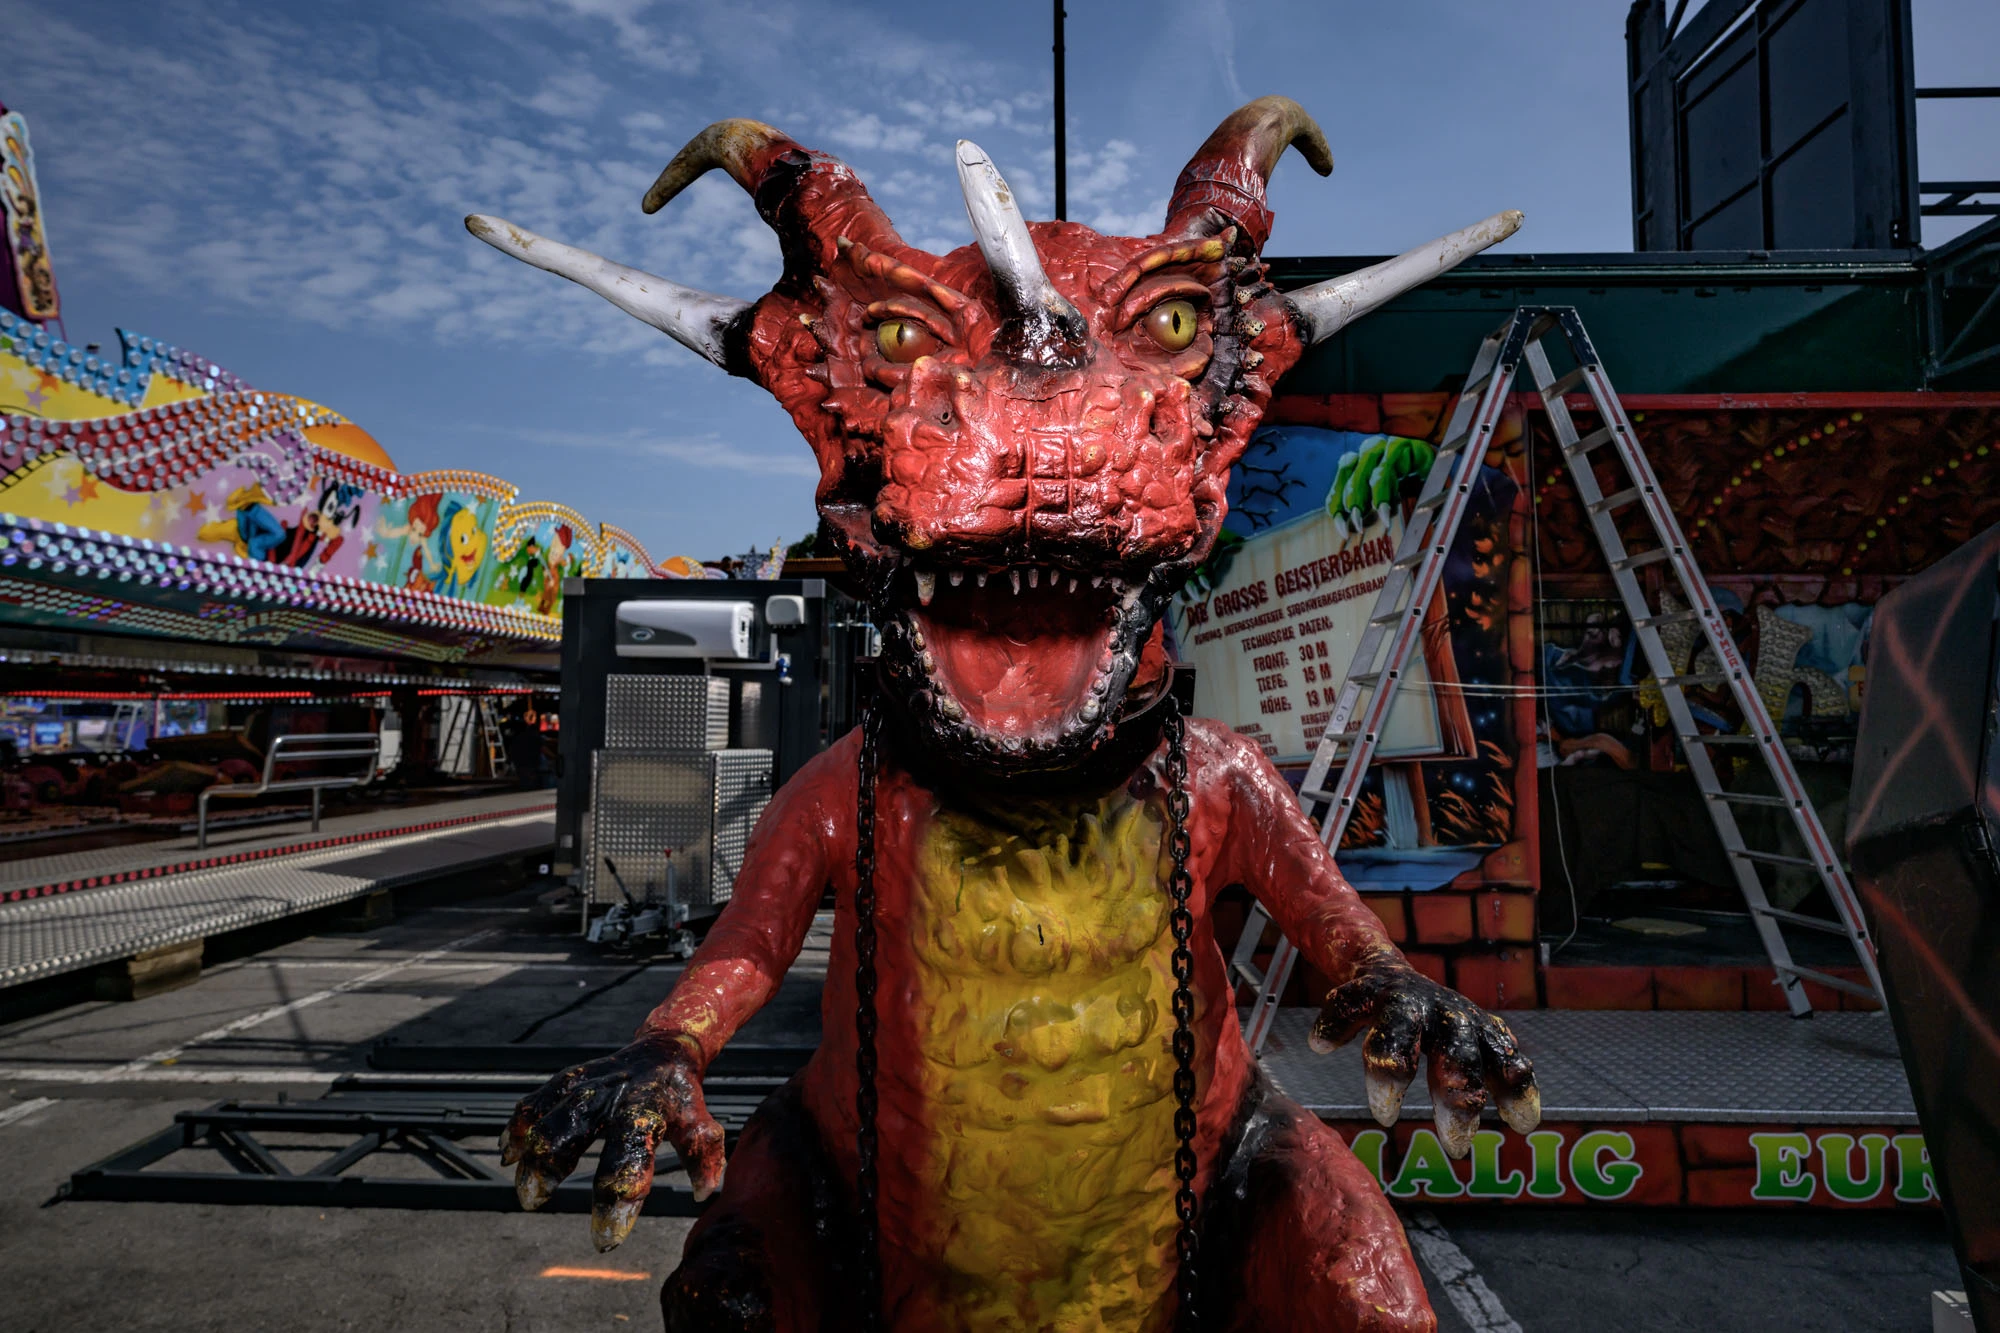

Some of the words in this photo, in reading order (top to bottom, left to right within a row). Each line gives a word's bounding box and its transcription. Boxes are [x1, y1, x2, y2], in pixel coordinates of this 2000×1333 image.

[1214, 580, 1269, 618] GROSSE
[1275, 534, 1395, 598] GEISTERBAHN
[1241, 626, 1296, 653] TECHNISCHE
[1298, 616, 1333, 637] DATEN:
[1253, 651, 1290, 673] FRONT:
[1299, 644, 1314, 662] 30
[1316, 640, 1328, 658] M
[1256, 673, 1288, 695] TIEFE:
[1302, 666, 1317, 684] 15
[1319, 662, 1332, 681] M
[1260, 695, 1292, 715] HÖHE:
[1306, 690, 1321, 708] 13
[1323, 686, 1336, 706] M
